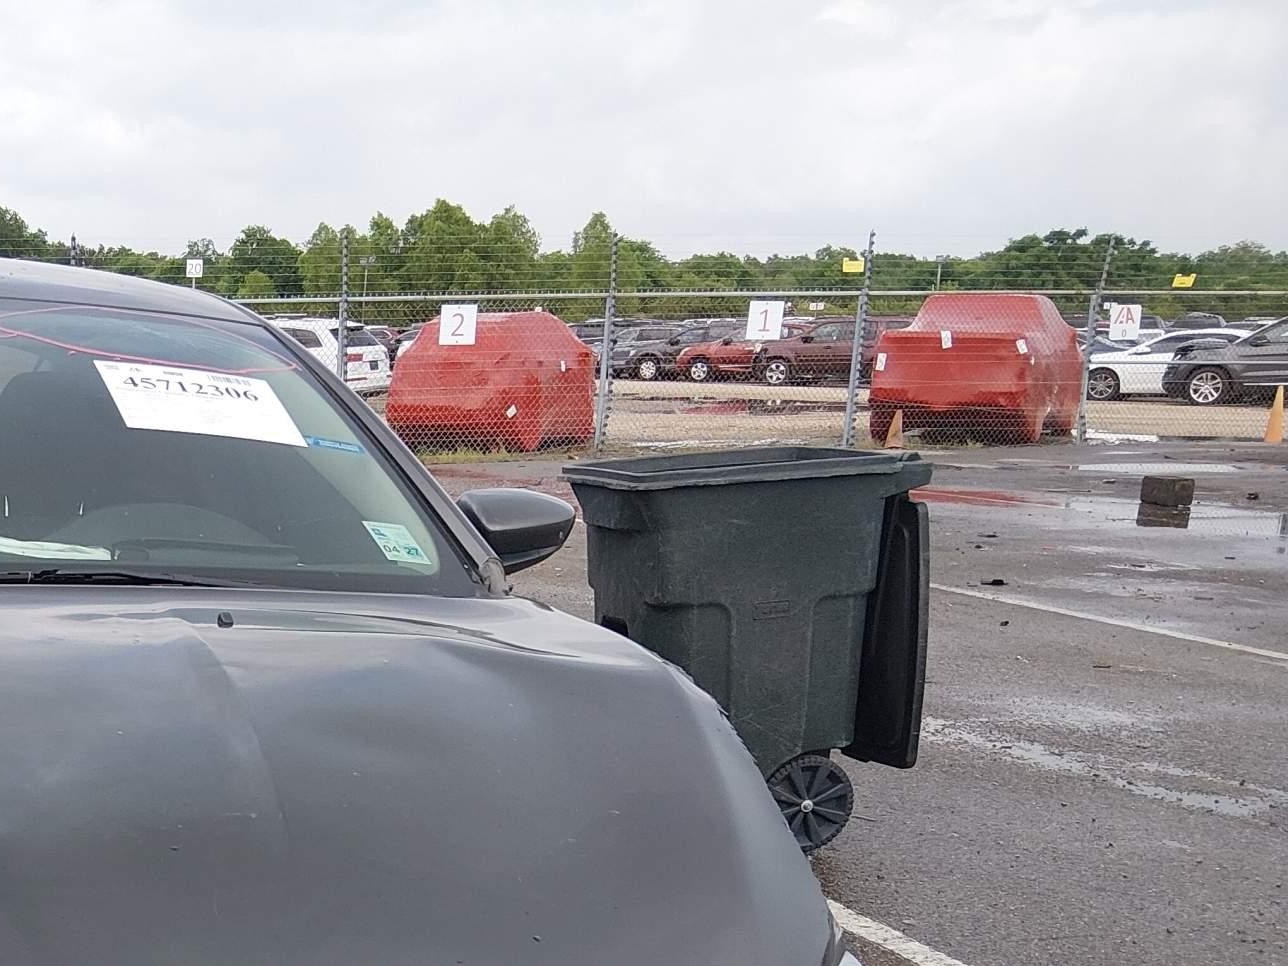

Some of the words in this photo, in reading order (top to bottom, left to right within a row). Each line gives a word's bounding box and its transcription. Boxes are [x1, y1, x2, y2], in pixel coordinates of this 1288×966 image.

[187, 263, 202, 275] 20
[451, 312, 465, 337] 2
[758, 308, 770, 332] 1
[122, 375, 260, 402] 45712306
